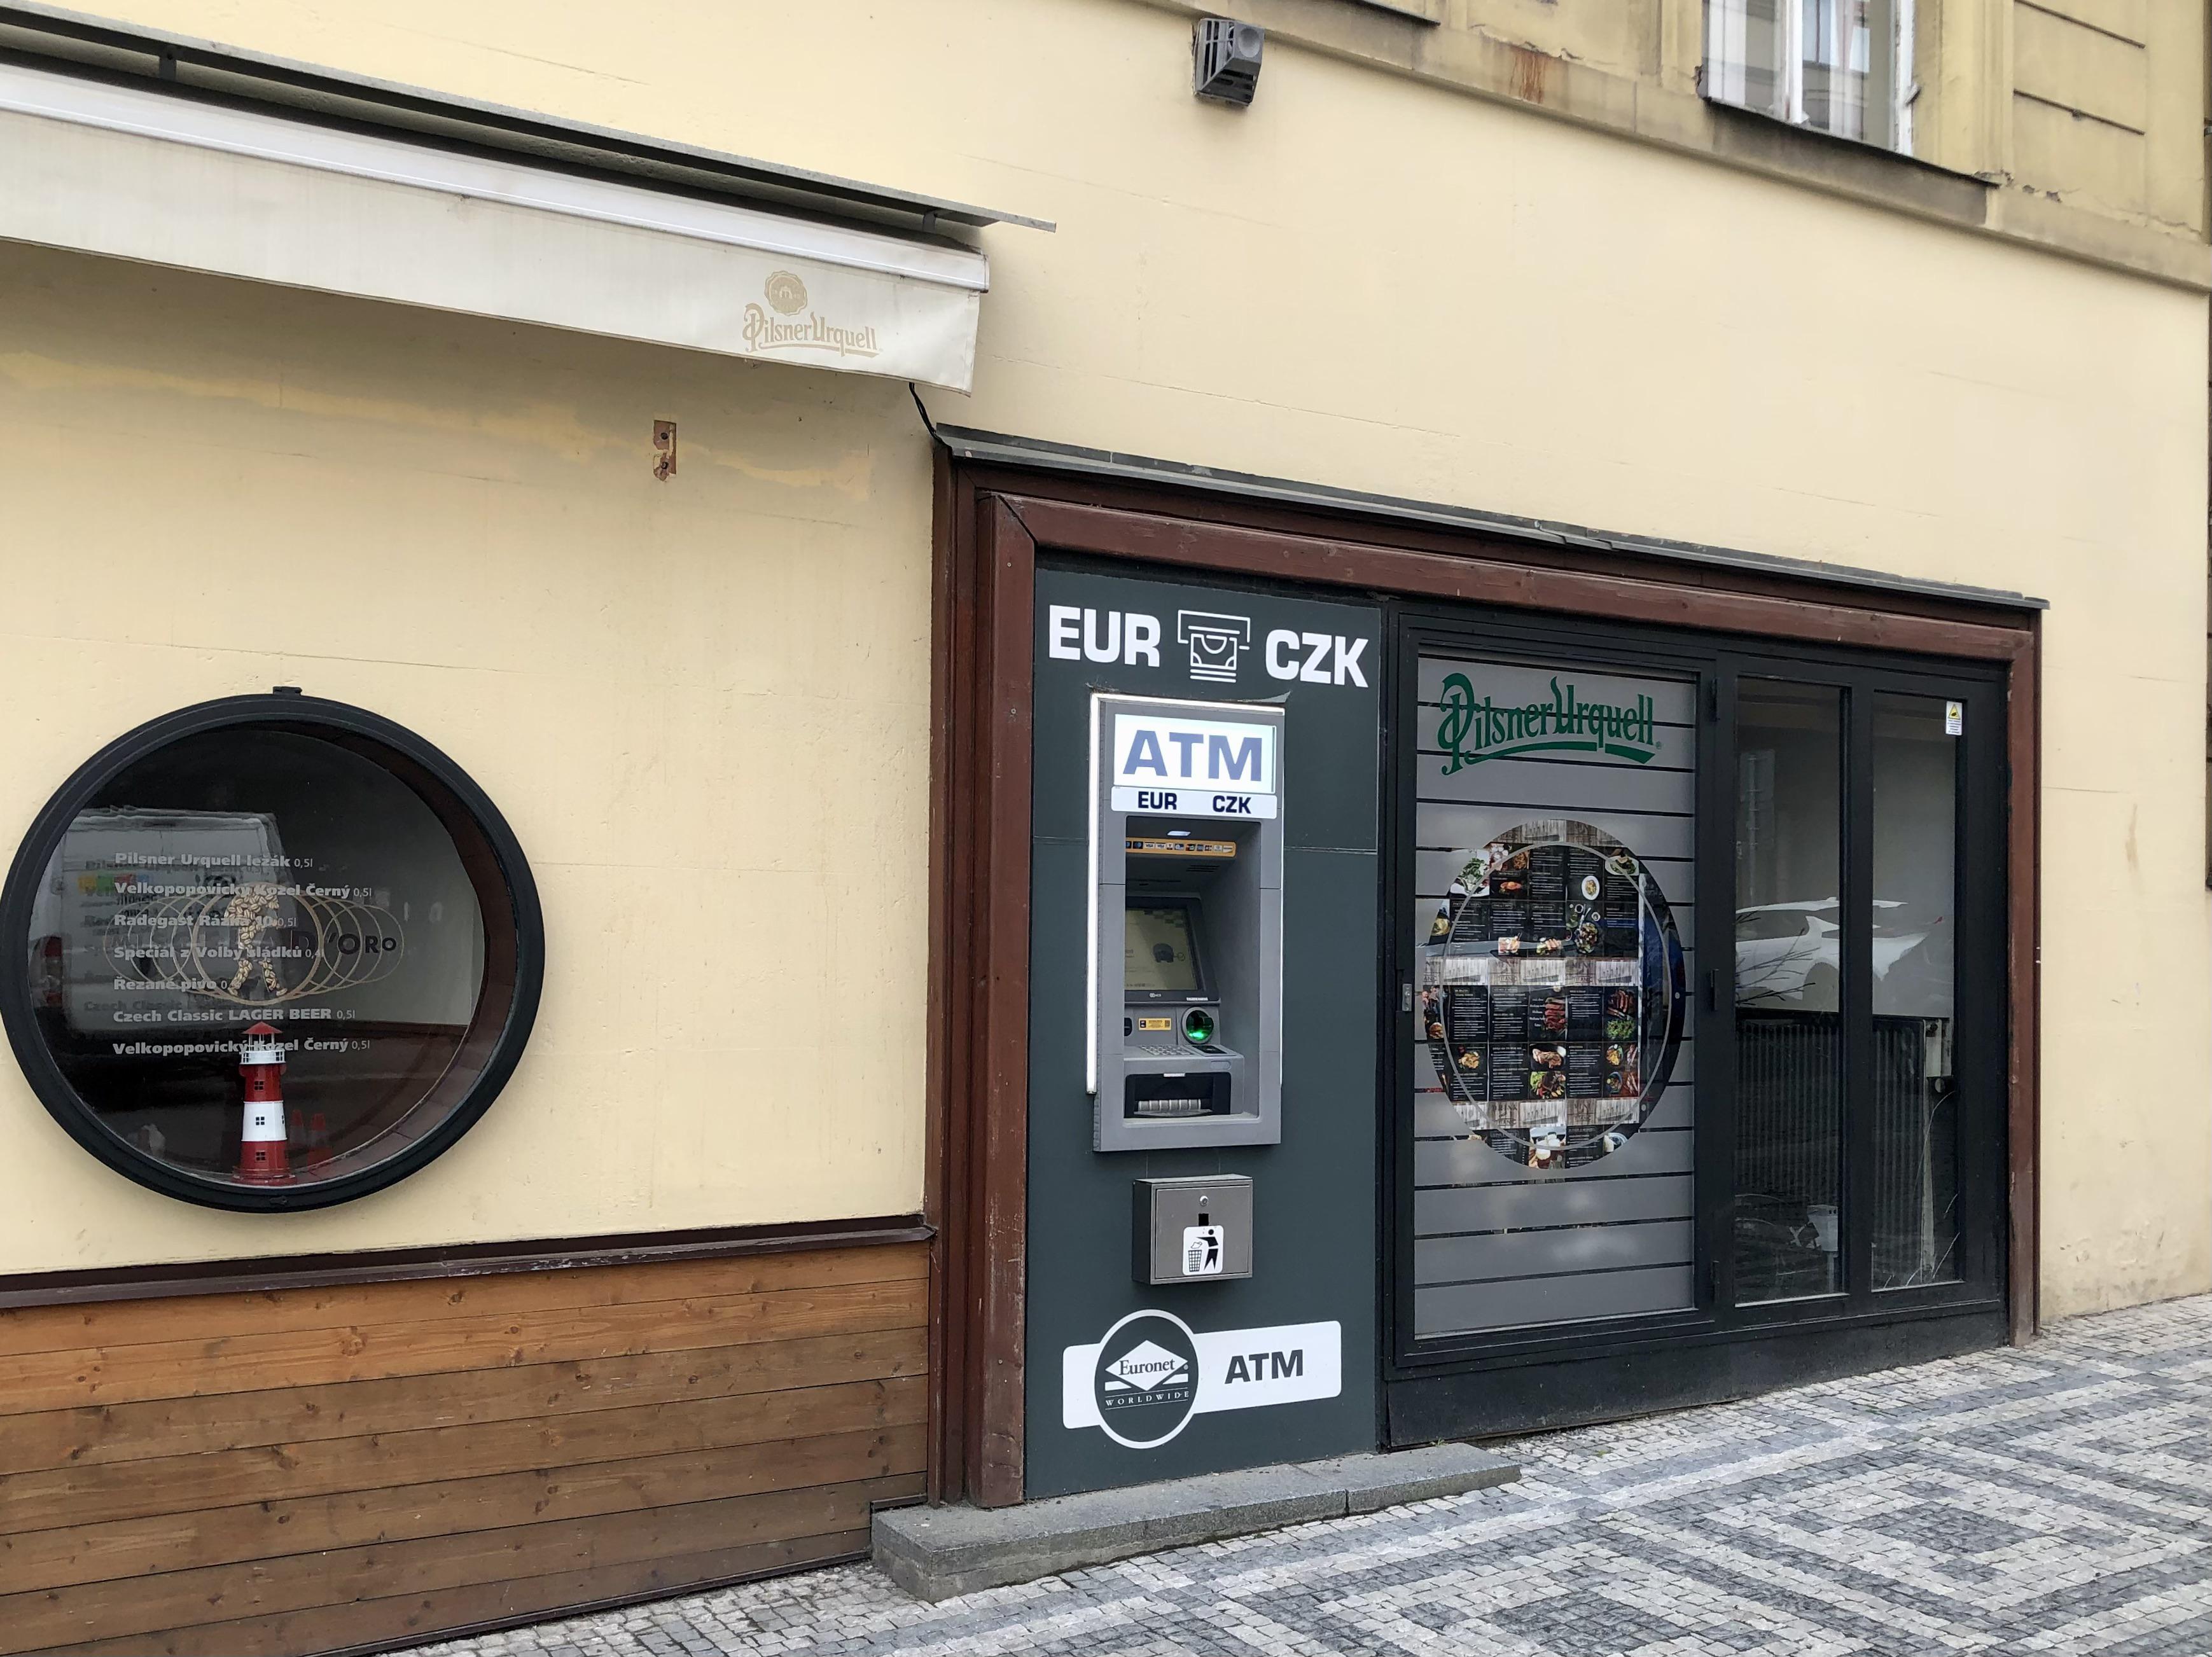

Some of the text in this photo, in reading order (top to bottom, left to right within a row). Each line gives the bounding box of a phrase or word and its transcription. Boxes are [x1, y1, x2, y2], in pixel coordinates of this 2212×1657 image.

[742, 303, 878, 357] Pilsner Urquell
[1049, 605, 1368, 688] EUR CZK
[1437, 672, 1653, 775] Pilsner Urquell
[1123, 730, 1262, 781] ATM
[1137, 791, 1251, 814] EUR CZK
[115, 852, 175, 864] Pilsner
[181, 854, 240, 868] Urquell
[254, 884, 300, 896] Kozel
[306, 883, 351, 899] Černý
[115, 915, 193, 929] Radegast
[180, 948, 190, 958] z
[195, 946, 242, 960] Volby
[181, 977, 217, 992] pivo
[113, 1010, 162, 1022] Czech
[167, 1009, 223, 1022] Classic
[229, 1009, 284, 1021] LAGER
[289, 1008, 331, 1020] BEER
[113, 1040, 248, 1057] Velkopopovický
[304, 1037, 349, 1053] Černý
[1118, 1358, 1175, 1375] Euronet
[1225, 1349, 1303, 1384] ATM
[1105, 1390, 1190, 1406] WORLDWIDE
